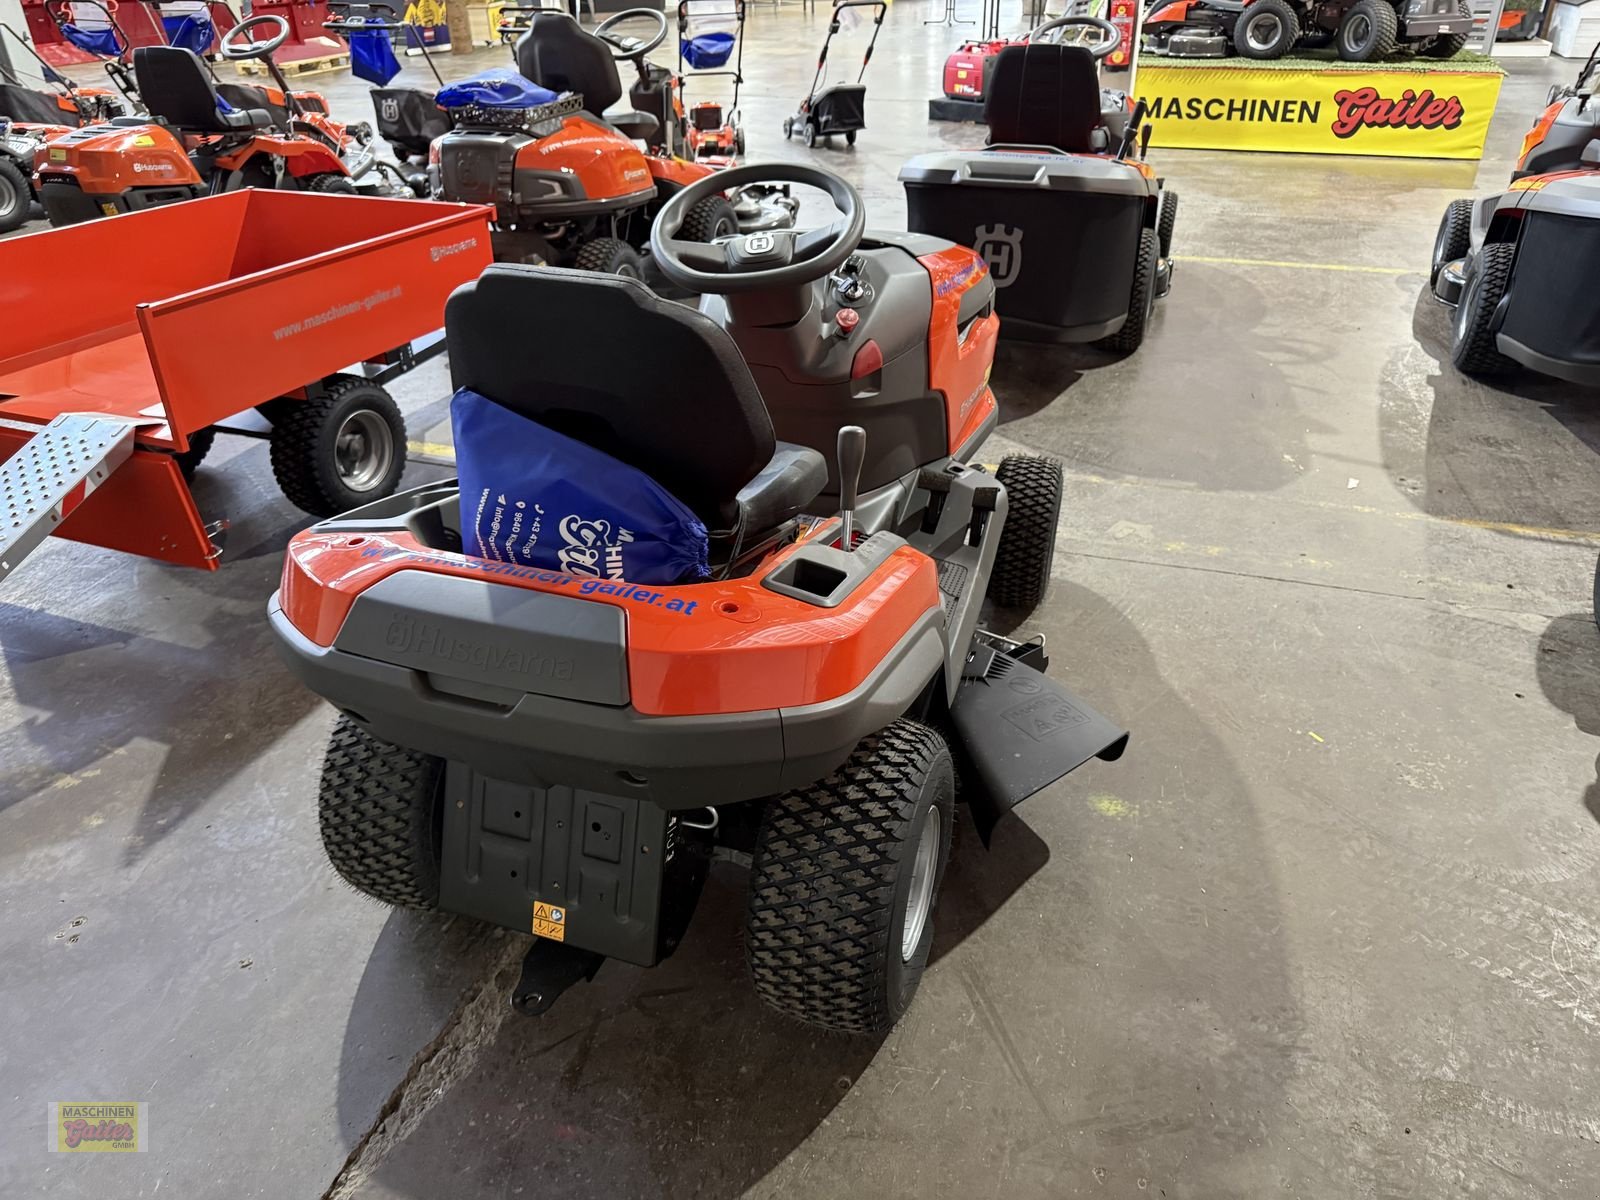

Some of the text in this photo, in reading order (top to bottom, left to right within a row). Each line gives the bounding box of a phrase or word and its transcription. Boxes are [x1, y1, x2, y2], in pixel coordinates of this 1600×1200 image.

[1141, 86, 1465, 139] MASCHINEN Gailer
[272, 286, 403, 341] www.maschinen-gailer.at
[511, 512, 523, 533] 9640
[531, 516, 541, 533] +43
[360, 546, 699, 616] ww.maschinen-gailer.at
[417, 624, 576, 682] Husqvarna
